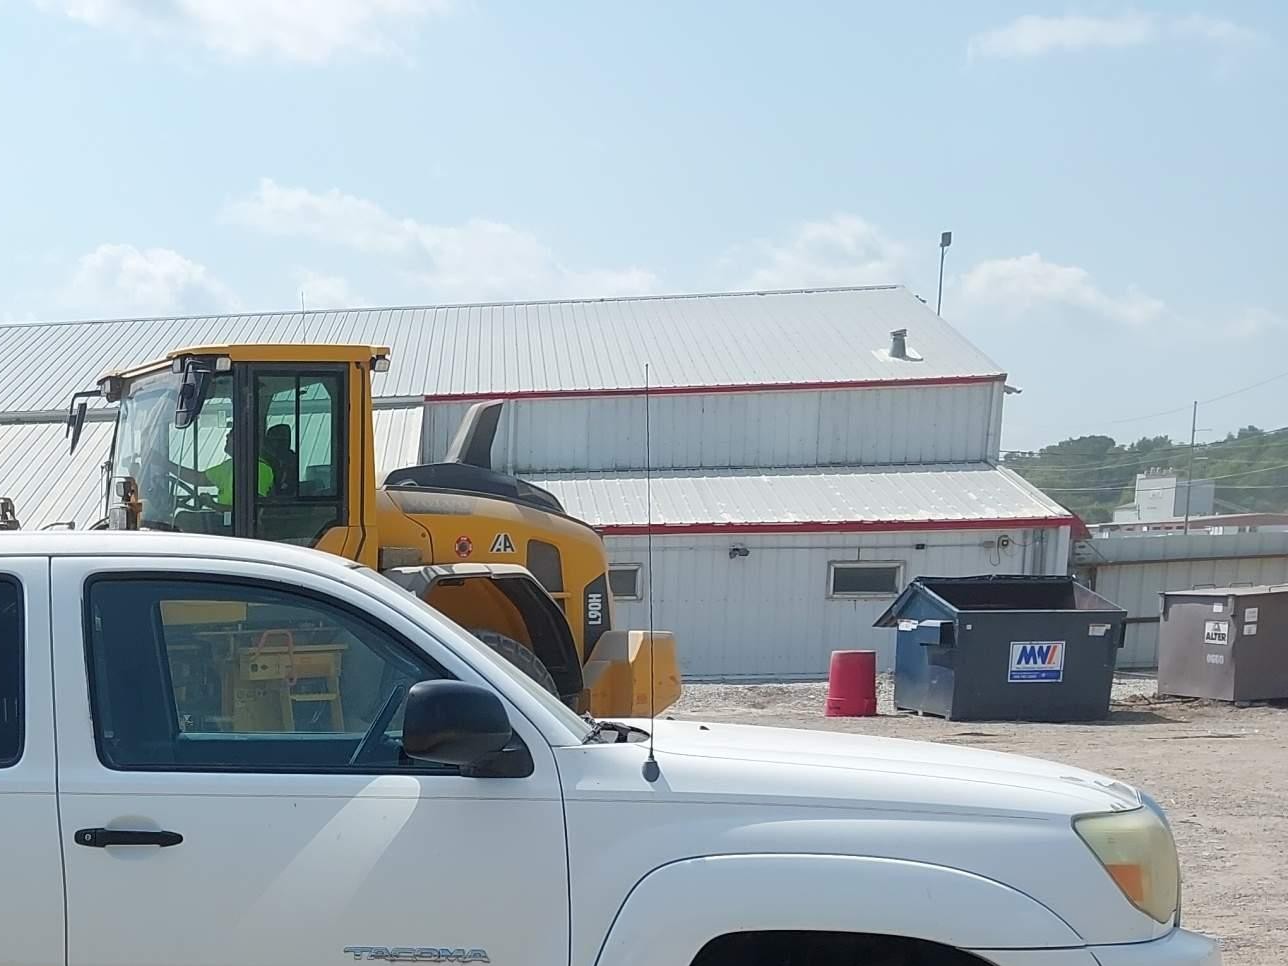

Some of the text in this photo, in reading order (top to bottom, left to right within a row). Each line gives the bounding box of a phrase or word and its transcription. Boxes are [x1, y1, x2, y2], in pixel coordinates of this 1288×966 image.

[588, 593, 603, 625] L90H
[1206, 632, 1226, 641] ALTER
[343, 945, 491, 964] TACOMA
